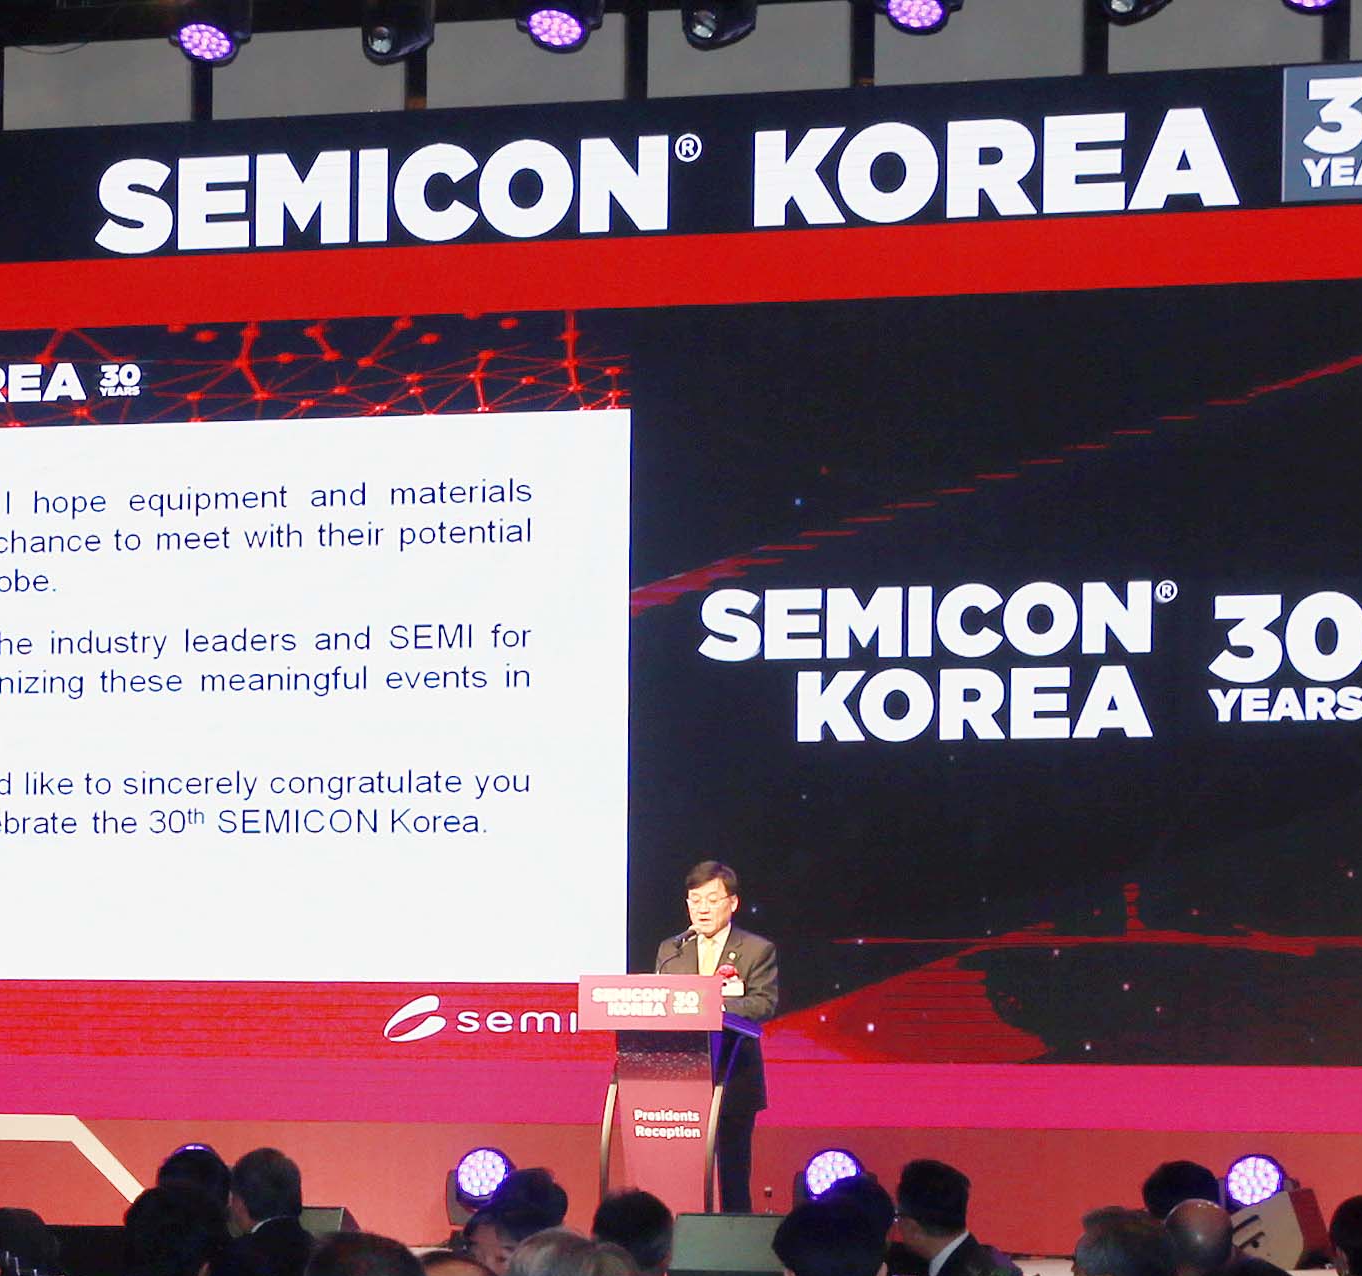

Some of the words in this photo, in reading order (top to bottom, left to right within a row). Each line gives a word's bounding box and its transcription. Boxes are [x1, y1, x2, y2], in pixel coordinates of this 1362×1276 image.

[753, 107, 1240, 227] KOREA
[99, 364, 141, 387] 30
[99, 385, 141, 397] YEARS
[6, 491, 11, 515] I
[34, 490, 106, 520] hope
[129, 486, 287, 517] equipment
[311, 482, 365, 507] and
[391, 478, 532, 505] materials
[114, 529, 141, 551] to
[157, 526, 230, 551] meet
[244, 523, 302, 548] with
[318, 521, 384, 547] their
[400, 517, 531, 552] potential
[51, 630, 167, 659] industry
[186, 627, 296, 653] leaders
[315, 625, 370, 650] and
[389, 624, 472, 649] SEMI
[491, 623, 531, 648] for
[100, 669, 182, 693] these
[201, 665, 367, 697] meaningful
[386, 666, 487, 689] events
[506, 663, 529, 688] in
[797, 665, 1154, 743] KOREA
[26, 771, 74, 795] like
[84, 773, 111, 795] to
[123, 770, 257, 801] sincerely
[270, 769, 462, 800] congratulate
[475, 775, 529, 799] you
[92, 810, 137, 834] the
[218, 809, 377, 834] SEMICON
[391, 808, 486, 833] Korea.
[634, 1109, 700, 1122] Presidents
[634, 1125, 701, 1140] Reception
